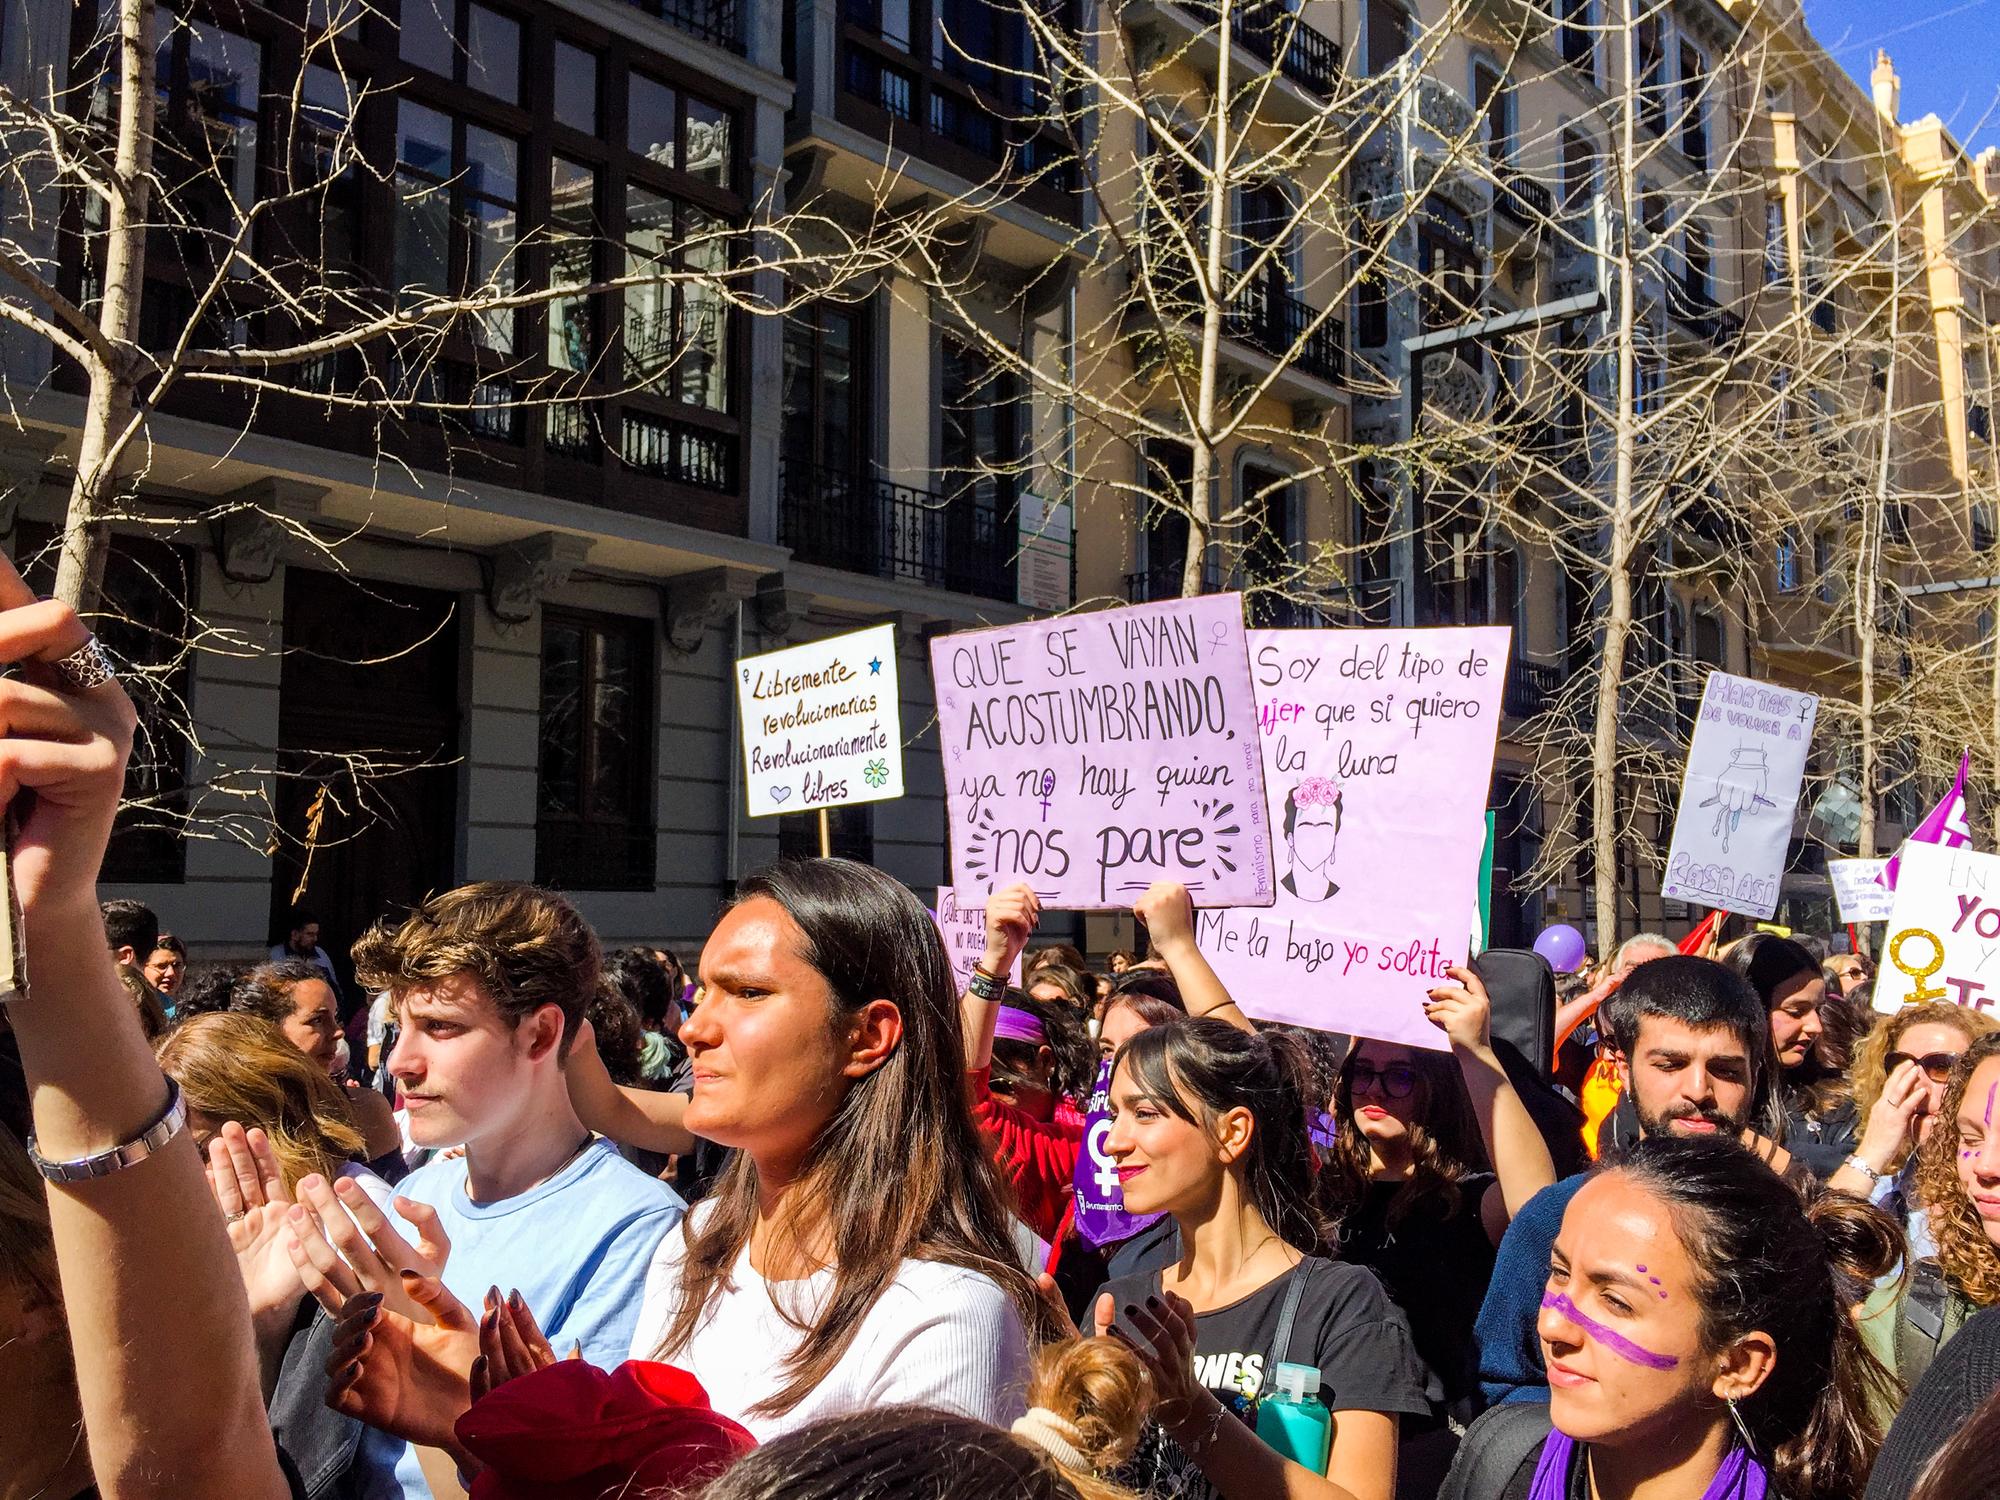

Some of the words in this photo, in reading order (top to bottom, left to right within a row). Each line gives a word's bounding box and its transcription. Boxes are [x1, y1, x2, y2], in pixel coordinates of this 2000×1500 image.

[952, 638, 1023, 689] QUE
[1046, 628, 1086, 678] SE
[1107, 614, 1200, 669] VAYAN
[1256, 645, 1321, 687] Soy
[1340, 643, 1391, 681] del
[1398, 641, 1444, 684] tipo
[1458, 648, 1489, 679] de
[752, 657, 857, 700] Libremente
[763, 694, 878, 737] revolucionarias
[966, 675, 1235, 751] ACOSTUMBRANDO,
[1256, 697, 1306, 736] ujer
[1315, 704, 1356, 740] que
[1406, 690, 1480, 740] quiero
[1701, 702, 1722, 722] DE
[752, 718, 888, 775] Revolucionariamente
[1275, 735, 1306, 773] la
[1337, 739, 1398, 779] luna
[802, 770, 848, 805] libres
[960, 773, 1006, 824] ya
[1016, 768, 1056, 800] no
[1079, 755, 1136, 811] hay
[1156, 755, 1234, 807] quien
[1248, 777, 1256, 792] no
[1251, 801, 1260, 825] para
[991, 828, 1070, 878] nos
[1096, 825, 1207, 902] pare
[1197, 910, 1239, 953] Me
[1247, 916, 1269, 958] la
[1286, 919, 1334, 973] bajo
[1342, 940, 1368, 977] yo
[1377, 937, 1453, 981] solita
